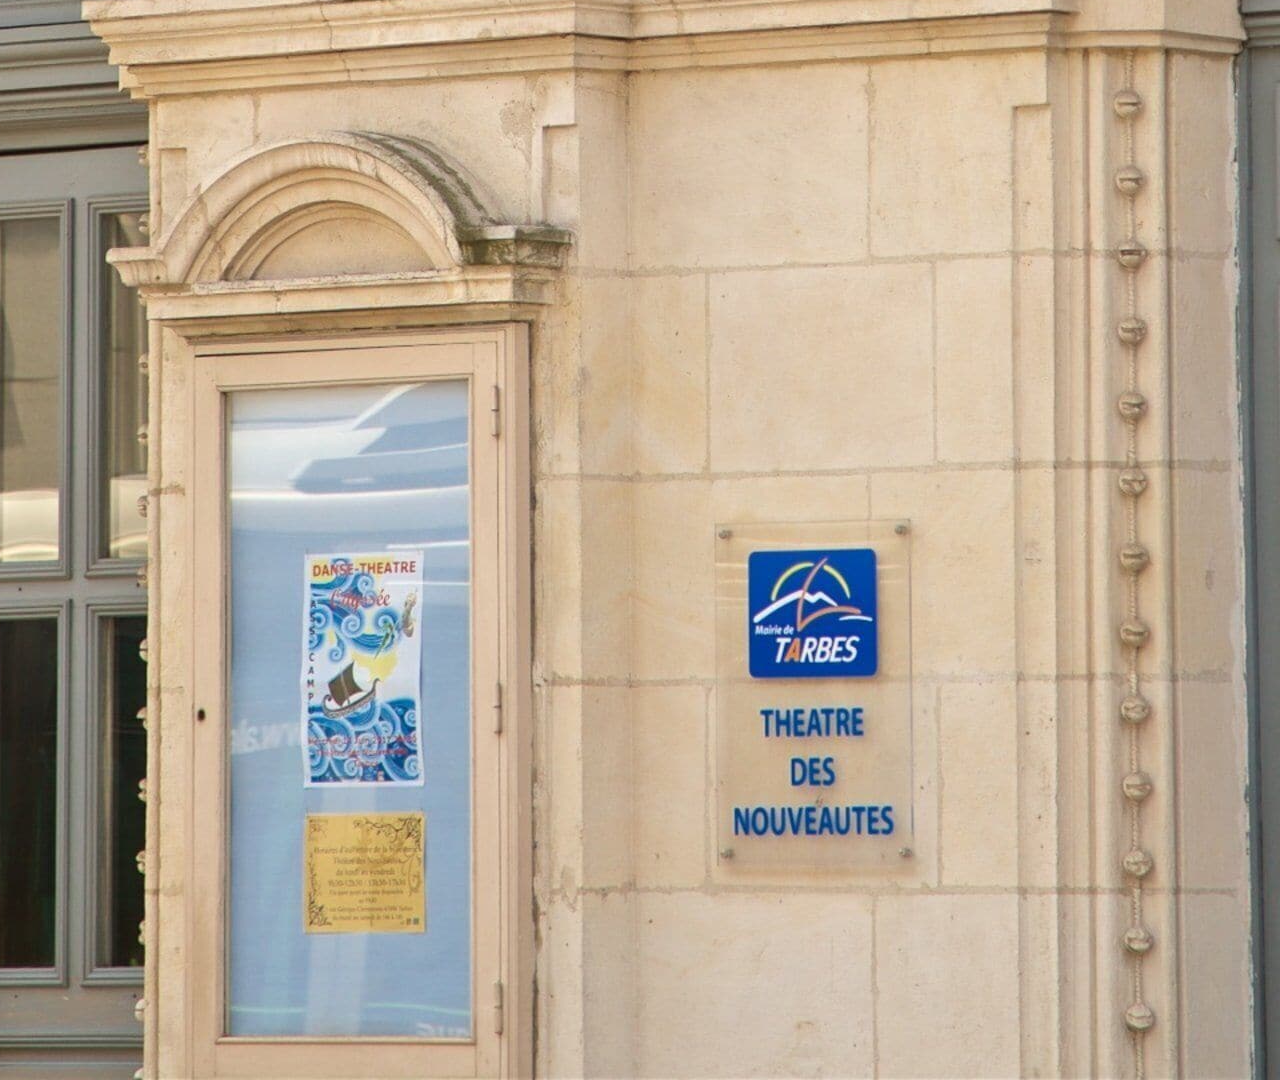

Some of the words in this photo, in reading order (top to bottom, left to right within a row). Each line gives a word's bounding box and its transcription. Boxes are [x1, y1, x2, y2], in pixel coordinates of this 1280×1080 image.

[313, 561, 416, 577] DANSE-THEATRE
[755, 624, 781, 636] Mairie
[782, 624, 794, 635] de
[775, 636, 860, 663] TARBES
[760, 708, 864, 738] THEATRE
[790, 757, 836, 786] DES
[734, 806, 894, 836] NOUVEAUTES
